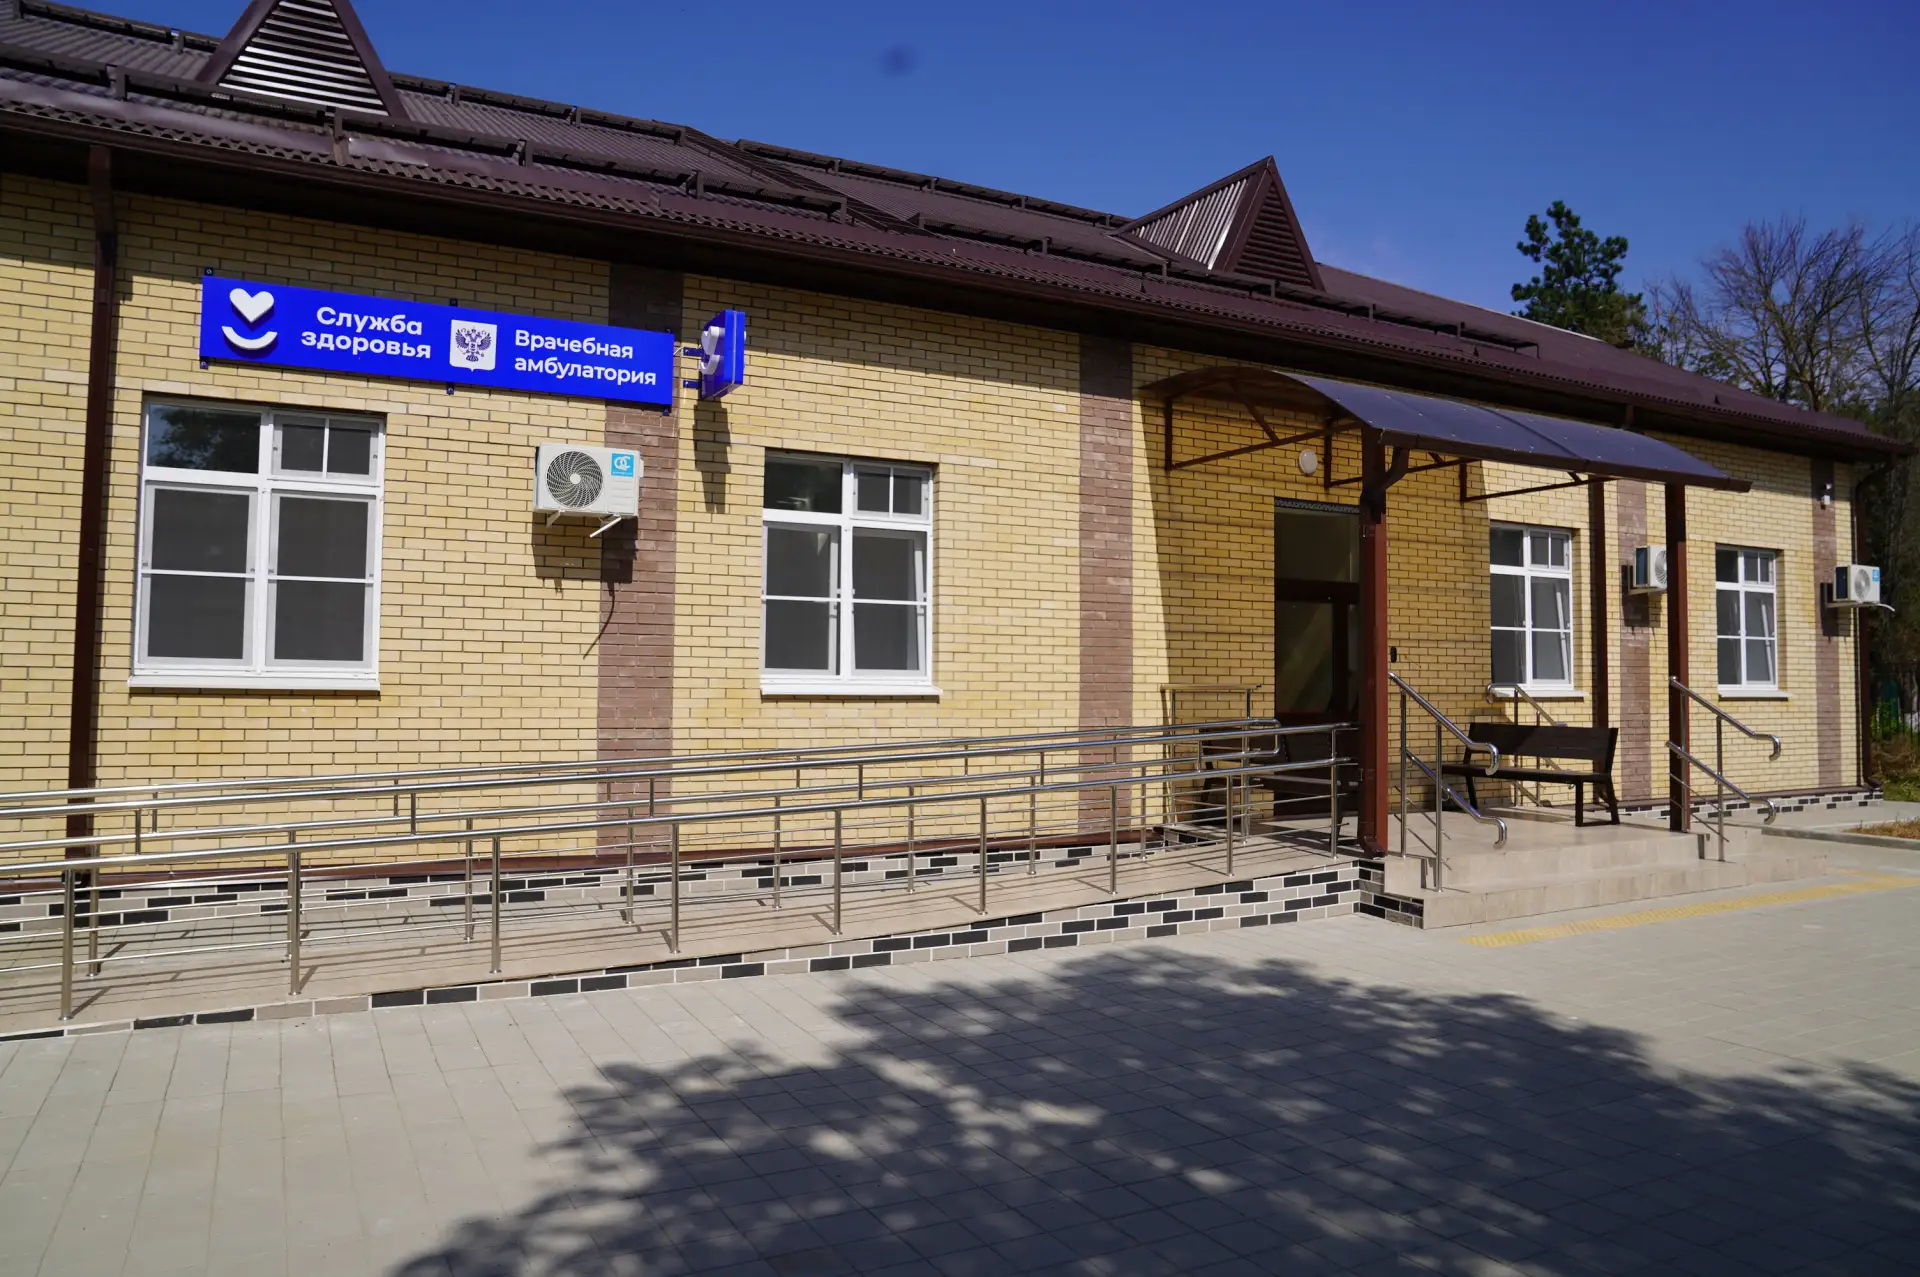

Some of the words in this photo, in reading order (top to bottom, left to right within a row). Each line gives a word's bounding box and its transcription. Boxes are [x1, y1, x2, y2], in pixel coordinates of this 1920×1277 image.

[316, 306, 423, 336] Служба
[301, 331, 431, 359] здоровья
[515, 329, 633, 359] Врачебная
[514, 357, 657, 386] амбулатория
